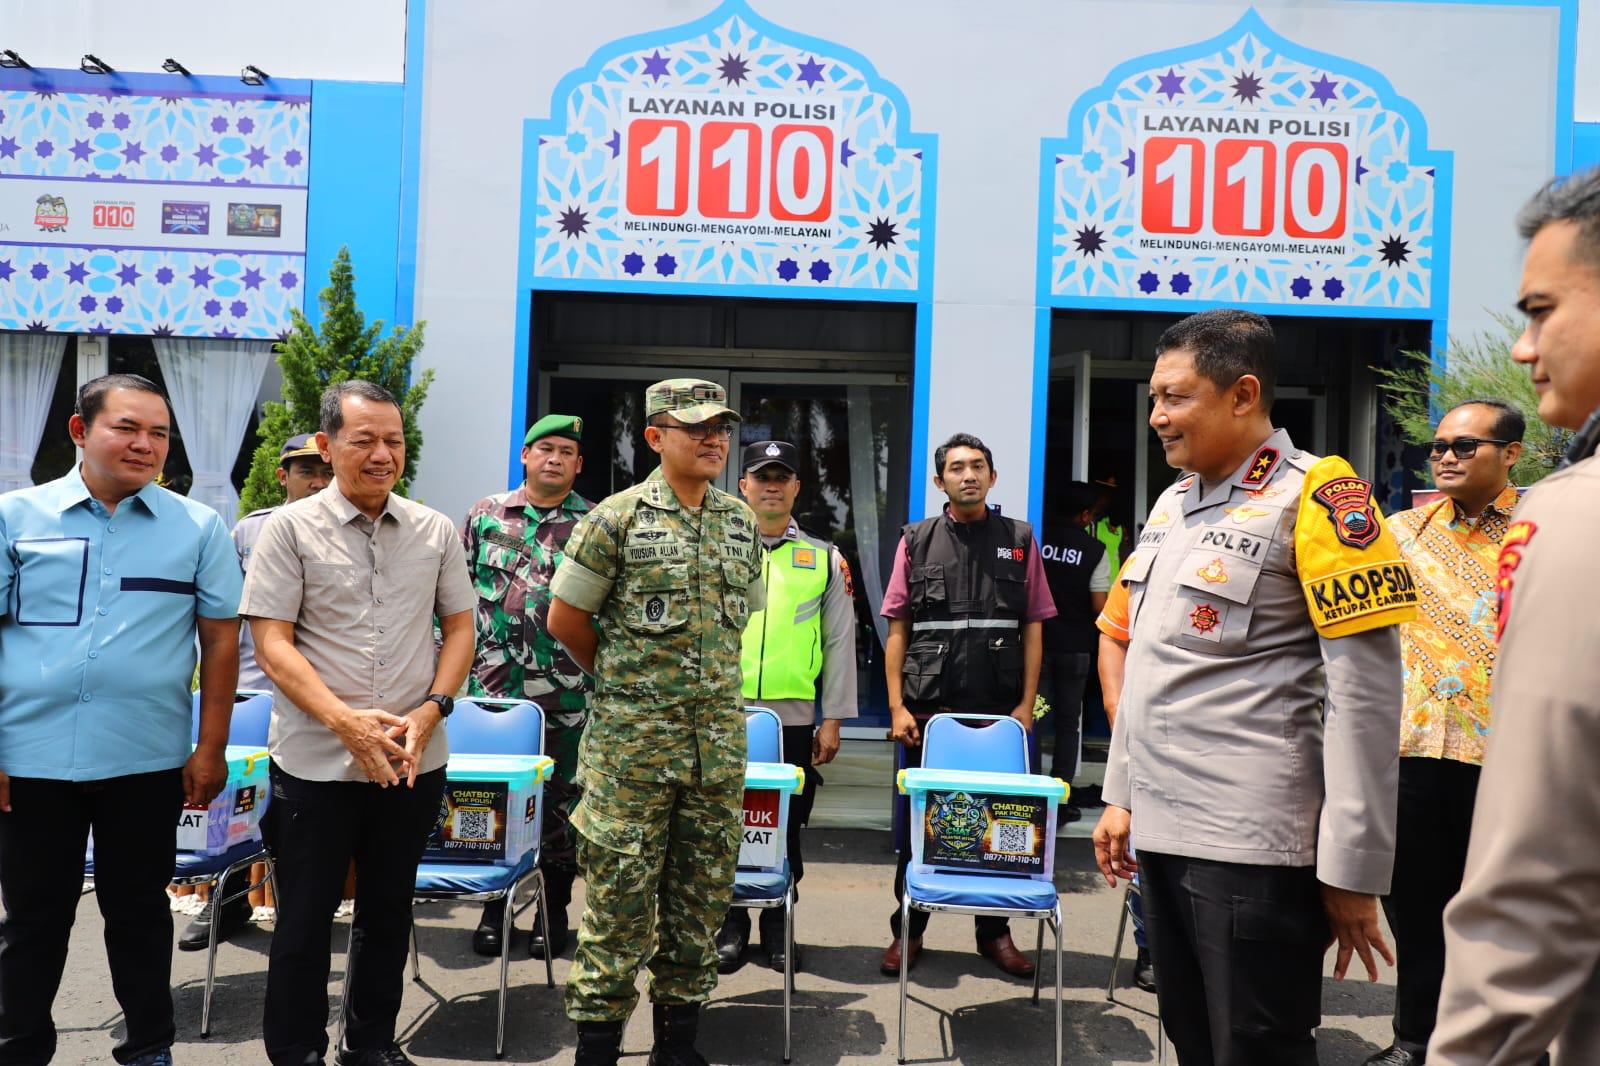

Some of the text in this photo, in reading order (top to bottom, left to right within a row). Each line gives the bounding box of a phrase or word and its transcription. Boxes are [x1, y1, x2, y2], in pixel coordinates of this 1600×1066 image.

[628, 97, 836, 120] LAYANAN POLISI
[1143, 115, 1350, 137] LAYANAN POLISI
[640, 125, 827, 216] 110
[1155, 144, 1342, 233] 110
[94, 206, 134, 227] 110
[624, 221, 831, 238] MELINDUNGI-MENGAYOMI-MELAYANI
[1140, 239, 1346, 255] MELINDUNGI-MENGAYOMI-MELAYANI
[1324, 481, 1365, 497] POLDA
[660, 546, 679, 557] ALLAN
[724, 545, 743, 558] TNI
[1201, 531, 1261, 557] POLRI
[1012, 547, 1024, 561] 119
[1041, 545, 1082, 566] OLISI
[1311, 565, 1416, 611] KAOPSDA
[1323, 599, 1373, 621] KETUPAT
[452, 790, 496, 799] CHATBOT
[992, 803, 1036, 813] CHATBOT
[946, 827, 971, 836] CHAT
[444, 841, 502, 851] 0877-110-110-10
[984, 853, 1040, 864] 0877-110-110-10
